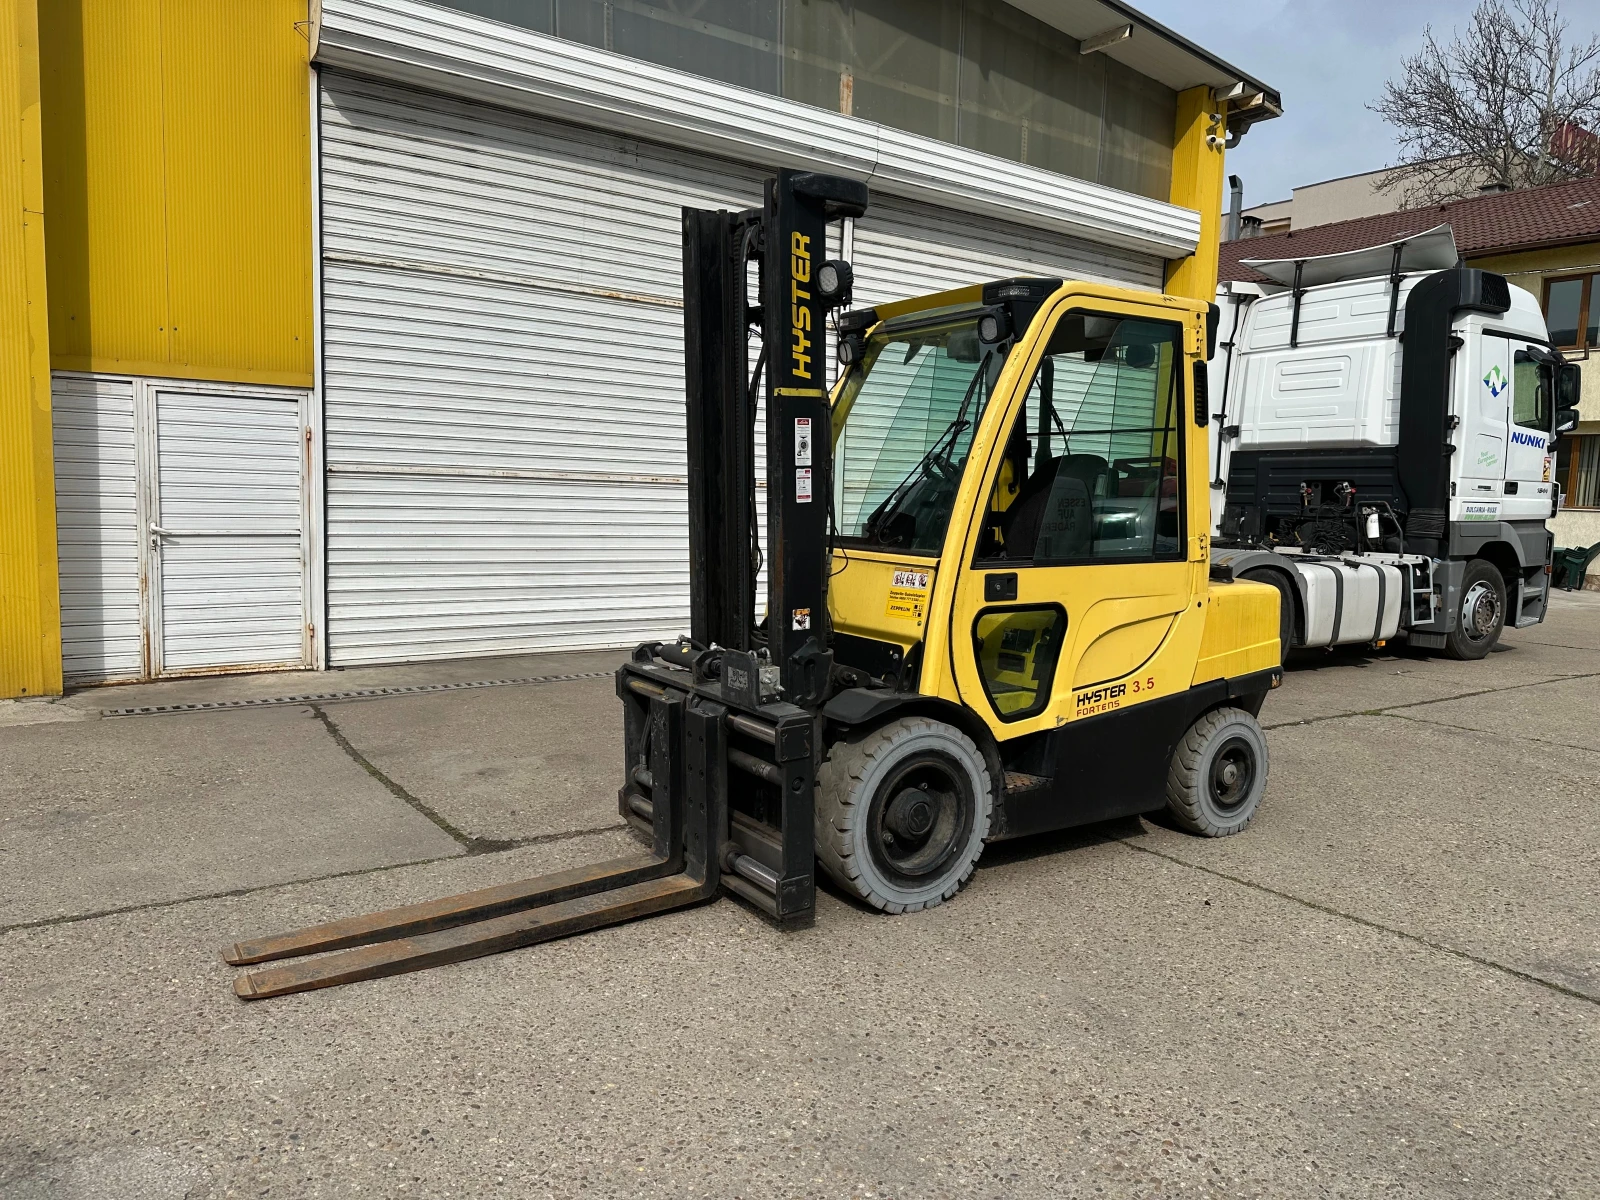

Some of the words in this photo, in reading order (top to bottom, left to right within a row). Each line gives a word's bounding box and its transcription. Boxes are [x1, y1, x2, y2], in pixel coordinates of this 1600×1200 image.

[791, 231, 811, 380] HYSTER
[1511, 431, 1546, 450] NUNKI
[1076, 683, 1127, 708] HYSTER
[1132, 677, 1155, 693] 3.5
[1076, 699, 1120, 717] FORTENS
